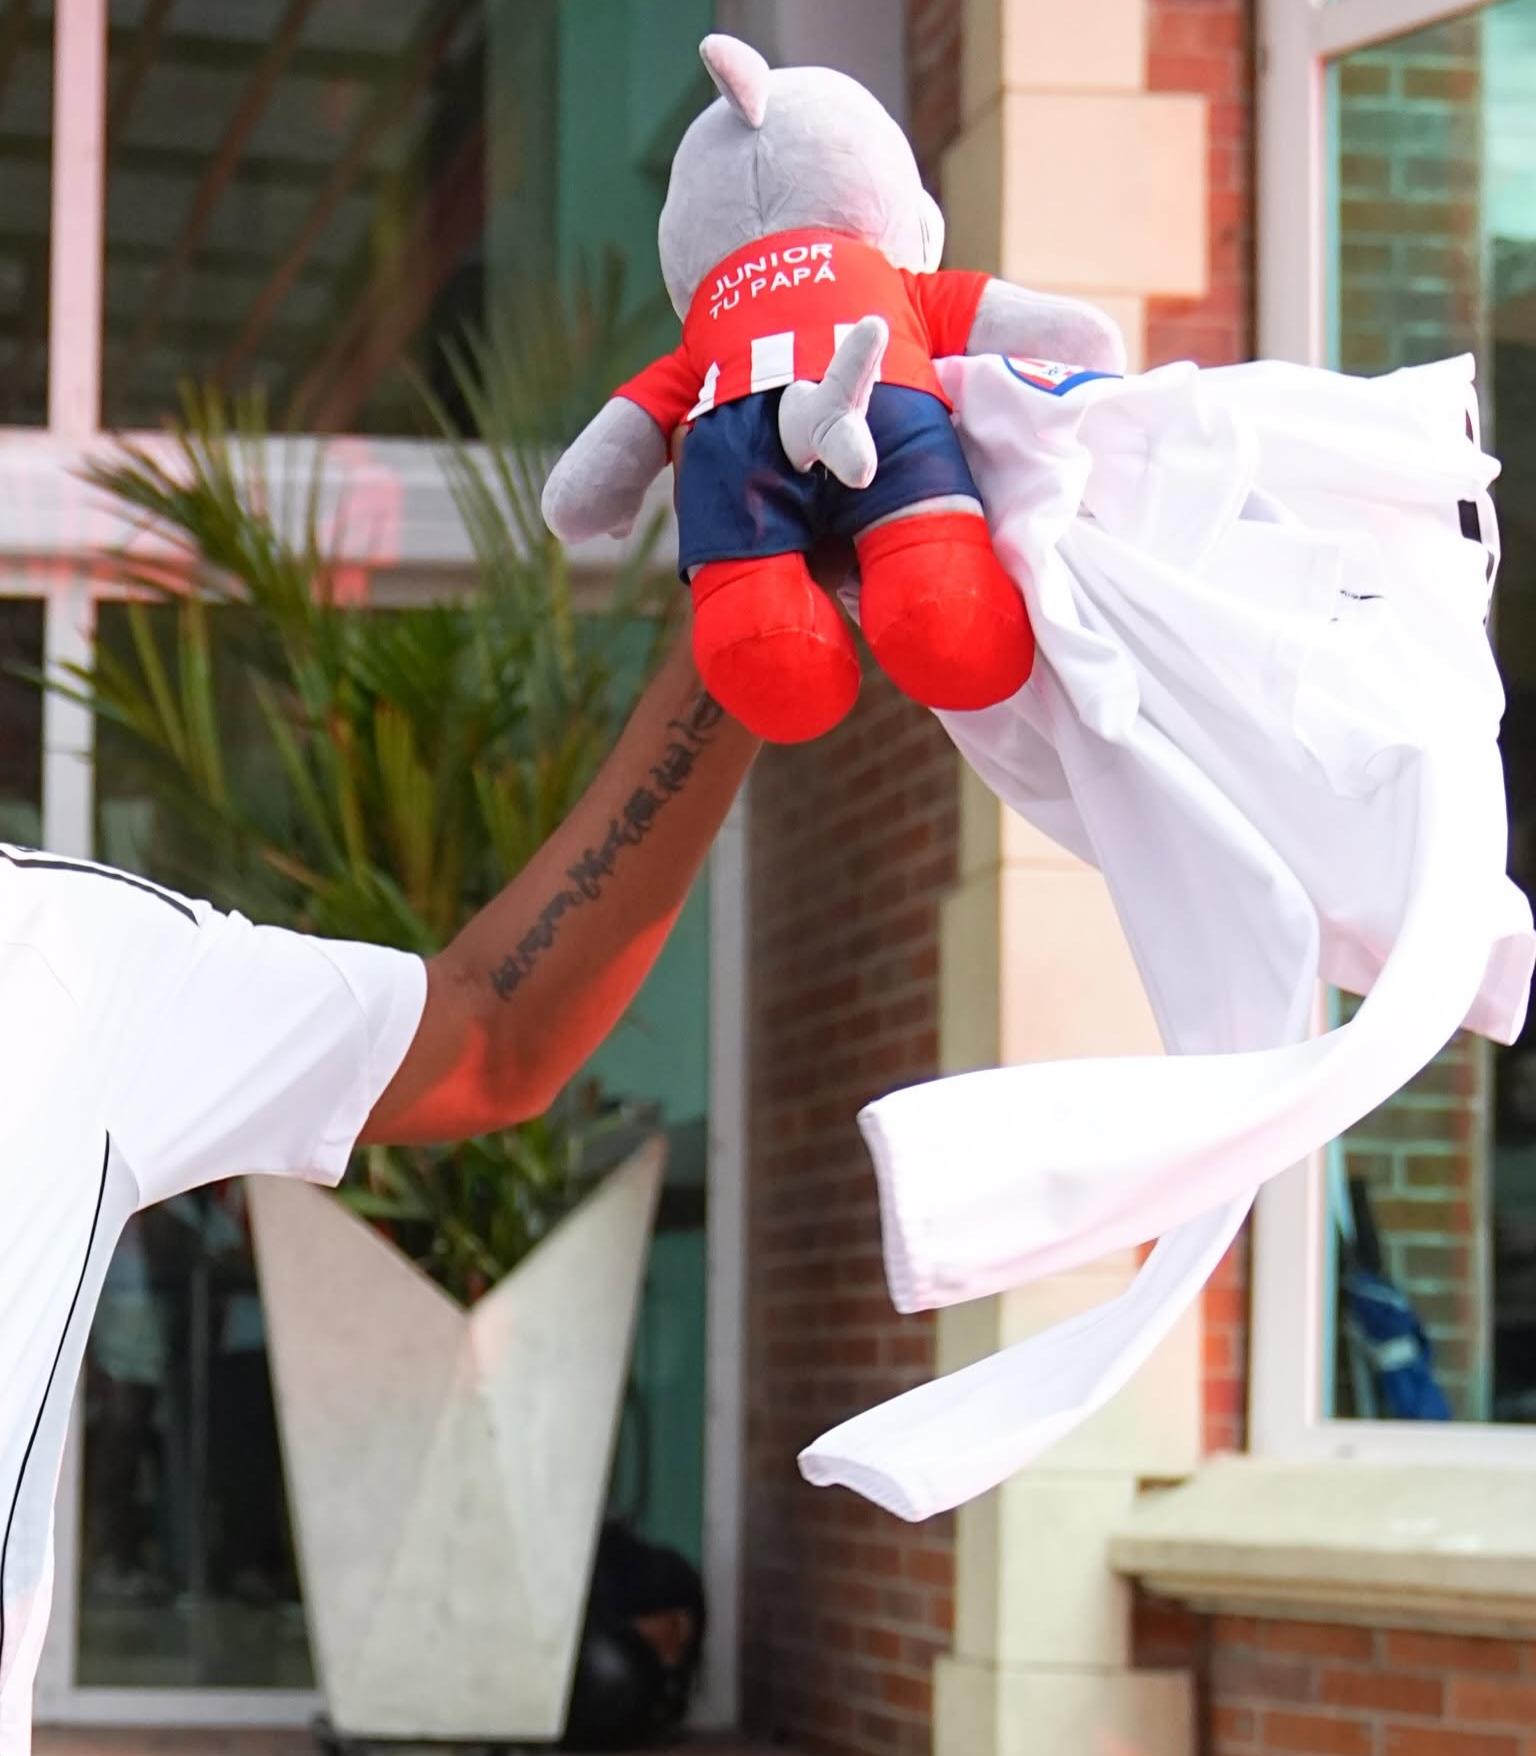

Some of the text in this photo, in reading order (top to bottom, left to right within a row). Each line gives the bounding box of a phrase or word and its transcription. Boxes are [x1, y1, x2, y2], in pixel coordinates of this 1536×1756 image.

[709, 260, 837, 320] TU PAPÁ
[710, 242, 833, 301] JUNIOR
